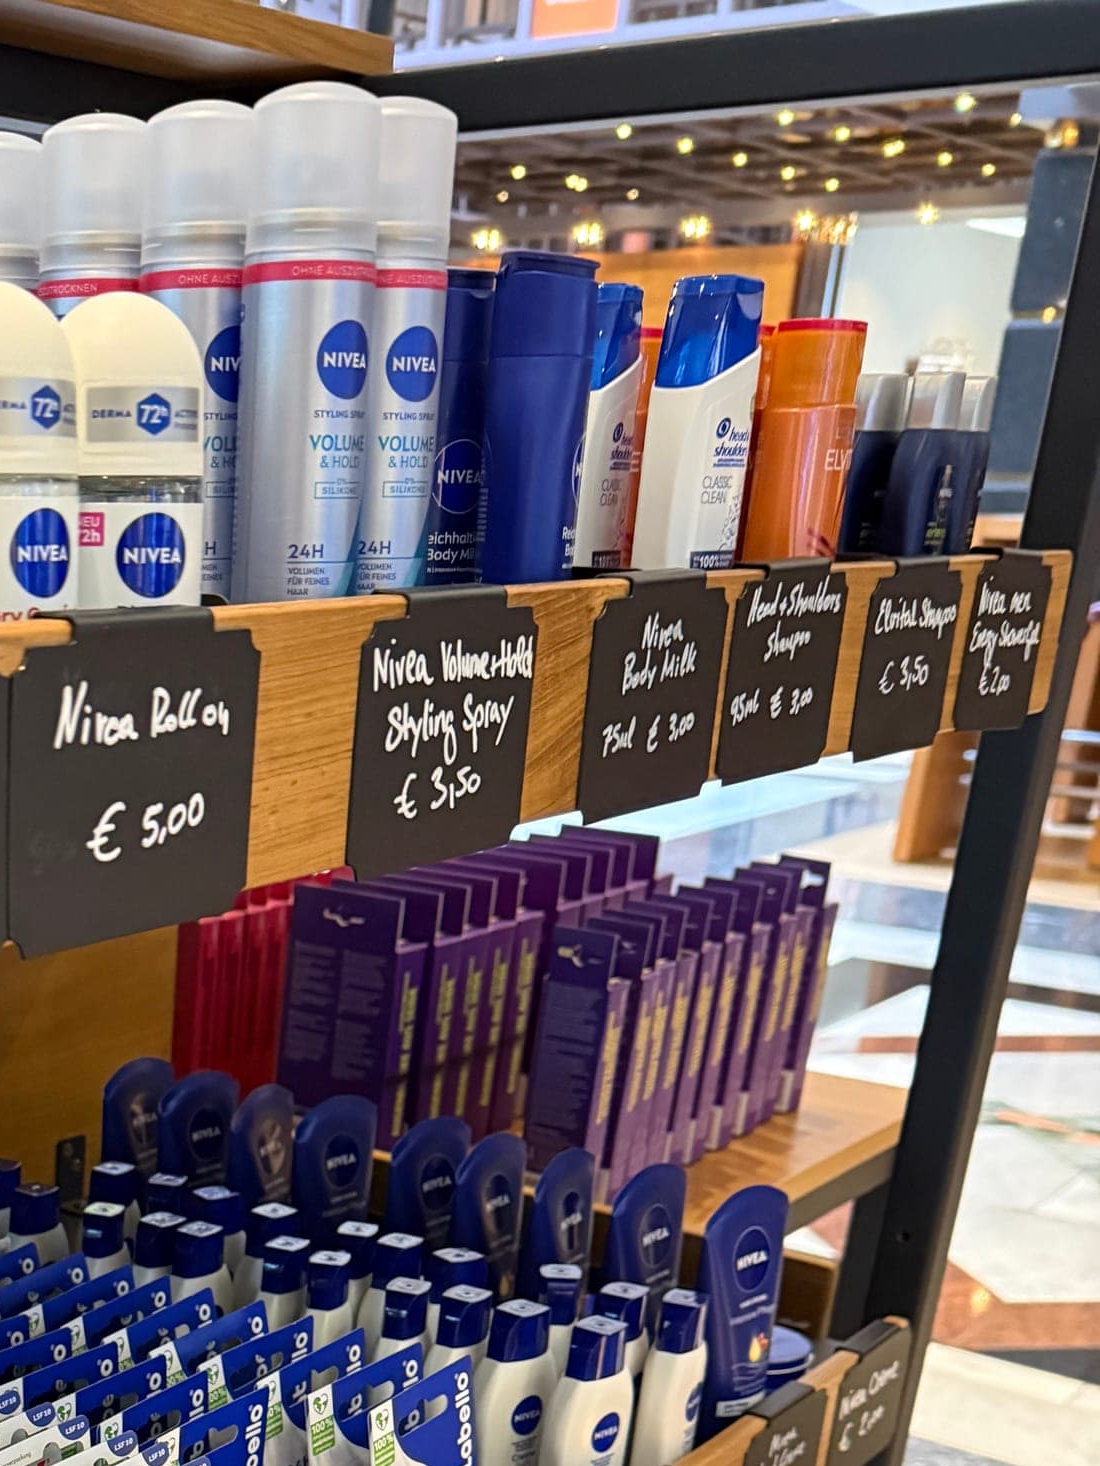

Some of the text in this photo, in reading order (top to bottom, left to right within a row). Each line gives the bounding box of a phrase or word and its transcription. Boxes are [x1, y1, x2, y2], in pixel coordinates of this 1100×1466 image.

[323, 351, 367, 369] NIVEA
[392, 356, 437, 374] NIVEA
[91, 409, 133, 420] DERMA
[309, 434, 365, 452] VOLUME
[378, 434, 435, 452] VOLUME
[320, 455, 360, 469] & HOLD
[388, 455, 428, 469] & HOLD
[437, 469, 482, 485] NIVEA
[17, 544, 69, 564] NIVEA
[123, 547, 182, 565] NIVEA
[288, 544, 324, 560] 24H
[358, 541, 392, 556] 24H
[641, 611, 684, 651] Nivea
[373, 638, 435, 692] Nivea
[622, 641, 699, 697] Body Milk
[878, 655, 930, 696] € 3,50
[770, 685, 785, 720] €
[53, 680, 140, 750] Nivea
[150, 686, 203, 739] Roll
[385, 692, 515, 766] Styling Spray
[647, 714, 662, 754] €
[668, 710, 696, 743] 3,00
[393, 765, 482, 820] € 3,50
[85, 792, 205, 863] € 5,00
[326, 1152, 357, 1172] NIVEA
[736, 1251, 768, 1271] NIVEA
[593, 1424, 619, 1441] NIVEA
